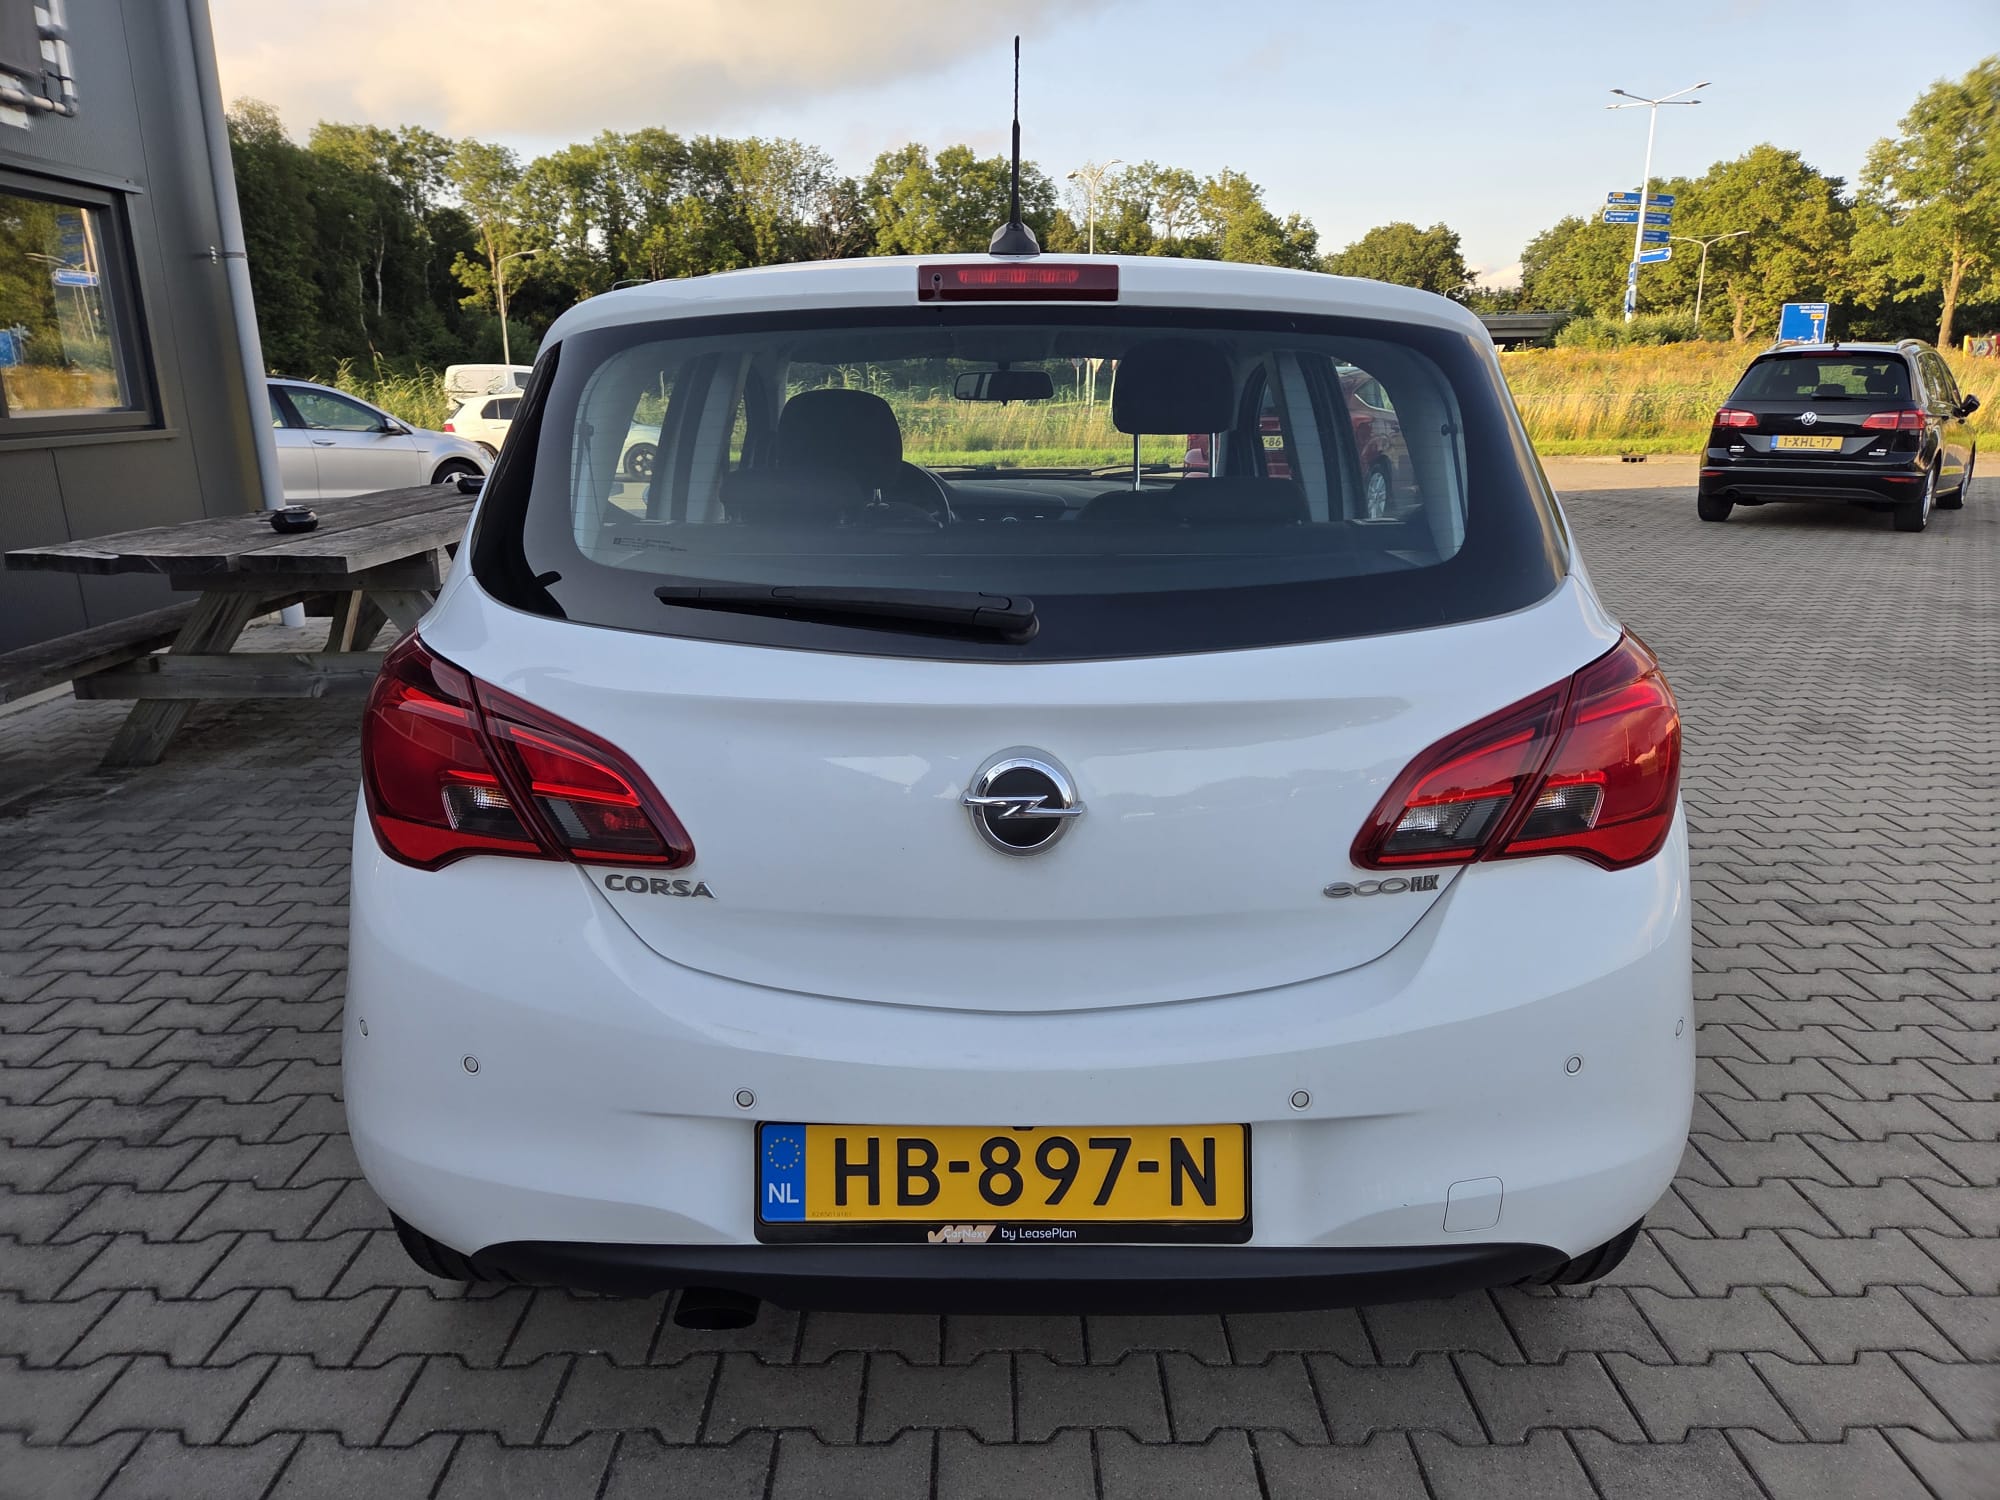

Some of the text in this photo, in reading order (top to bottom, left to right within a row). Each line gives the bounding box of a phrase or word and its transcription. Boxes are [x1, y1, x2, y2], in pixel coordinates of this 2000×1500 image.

[1784, 437, 1833, 448] 1-XHL-17
[604, 874, 718, 899] CORSA
[834, 1136, 1217, 1207] HB-897-N
[768, 1182, 800, 1204] NL
[943, 1227, 1077, 1241] CarNext by LeasePlan
